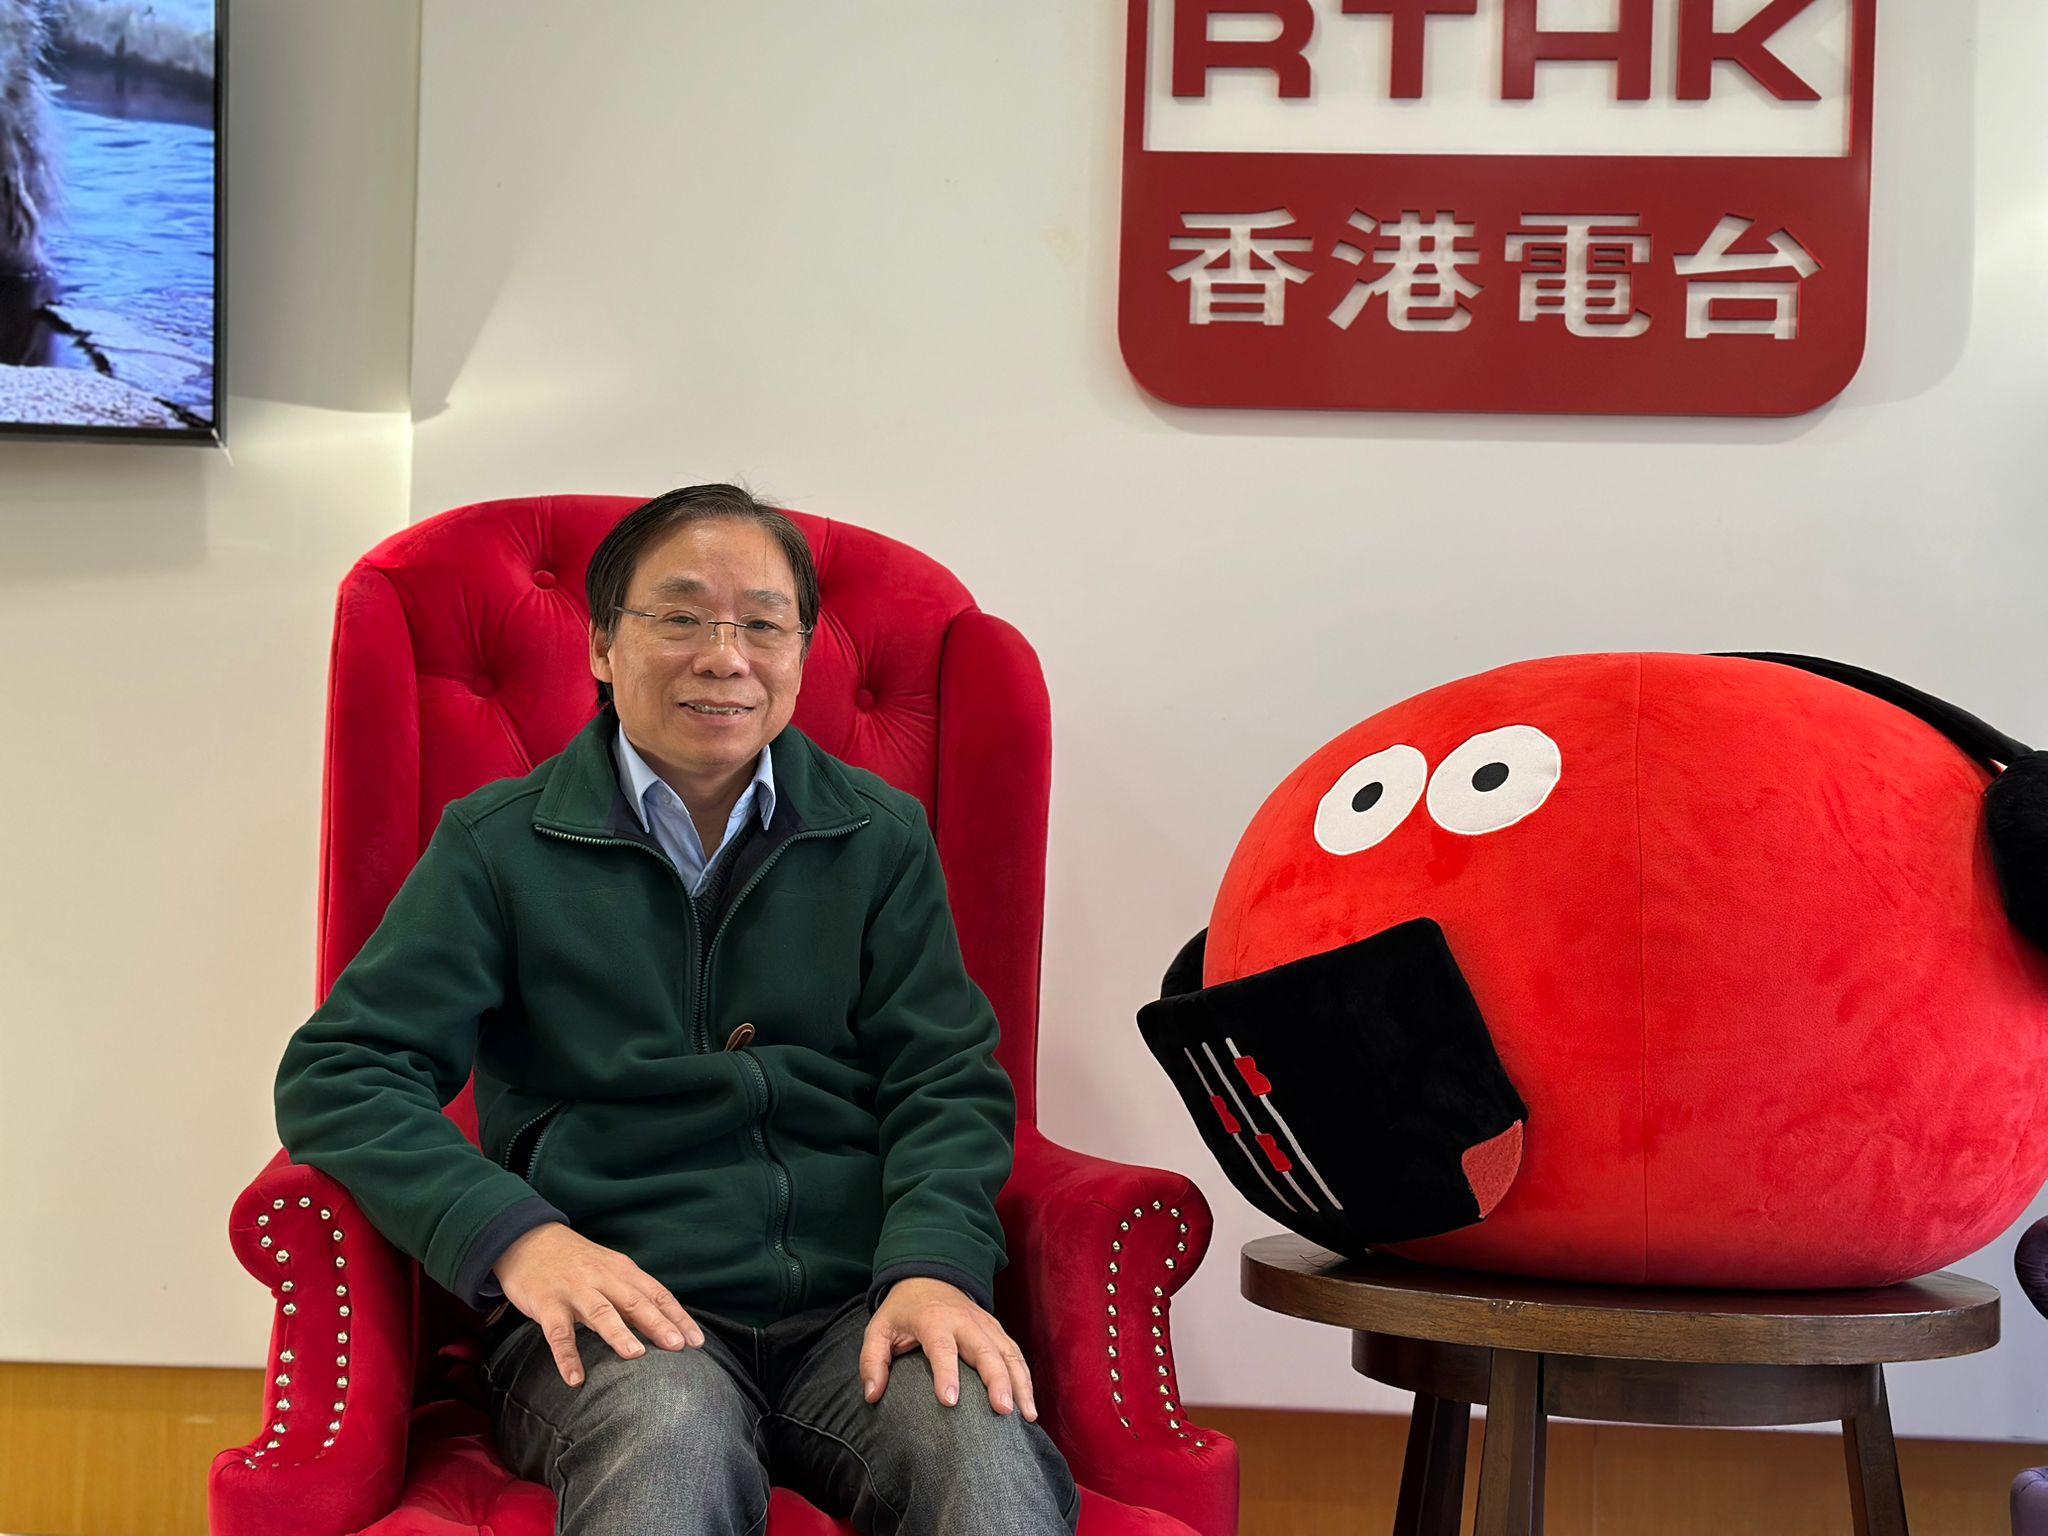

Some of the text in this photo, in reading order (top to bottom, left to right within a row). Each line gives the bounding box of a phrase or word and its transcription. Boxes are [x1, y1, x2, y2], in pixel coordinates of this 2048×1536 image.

[1171, 0, 1822, 101] RTHK
[1167, 207, 1824, 341] 香港電台
